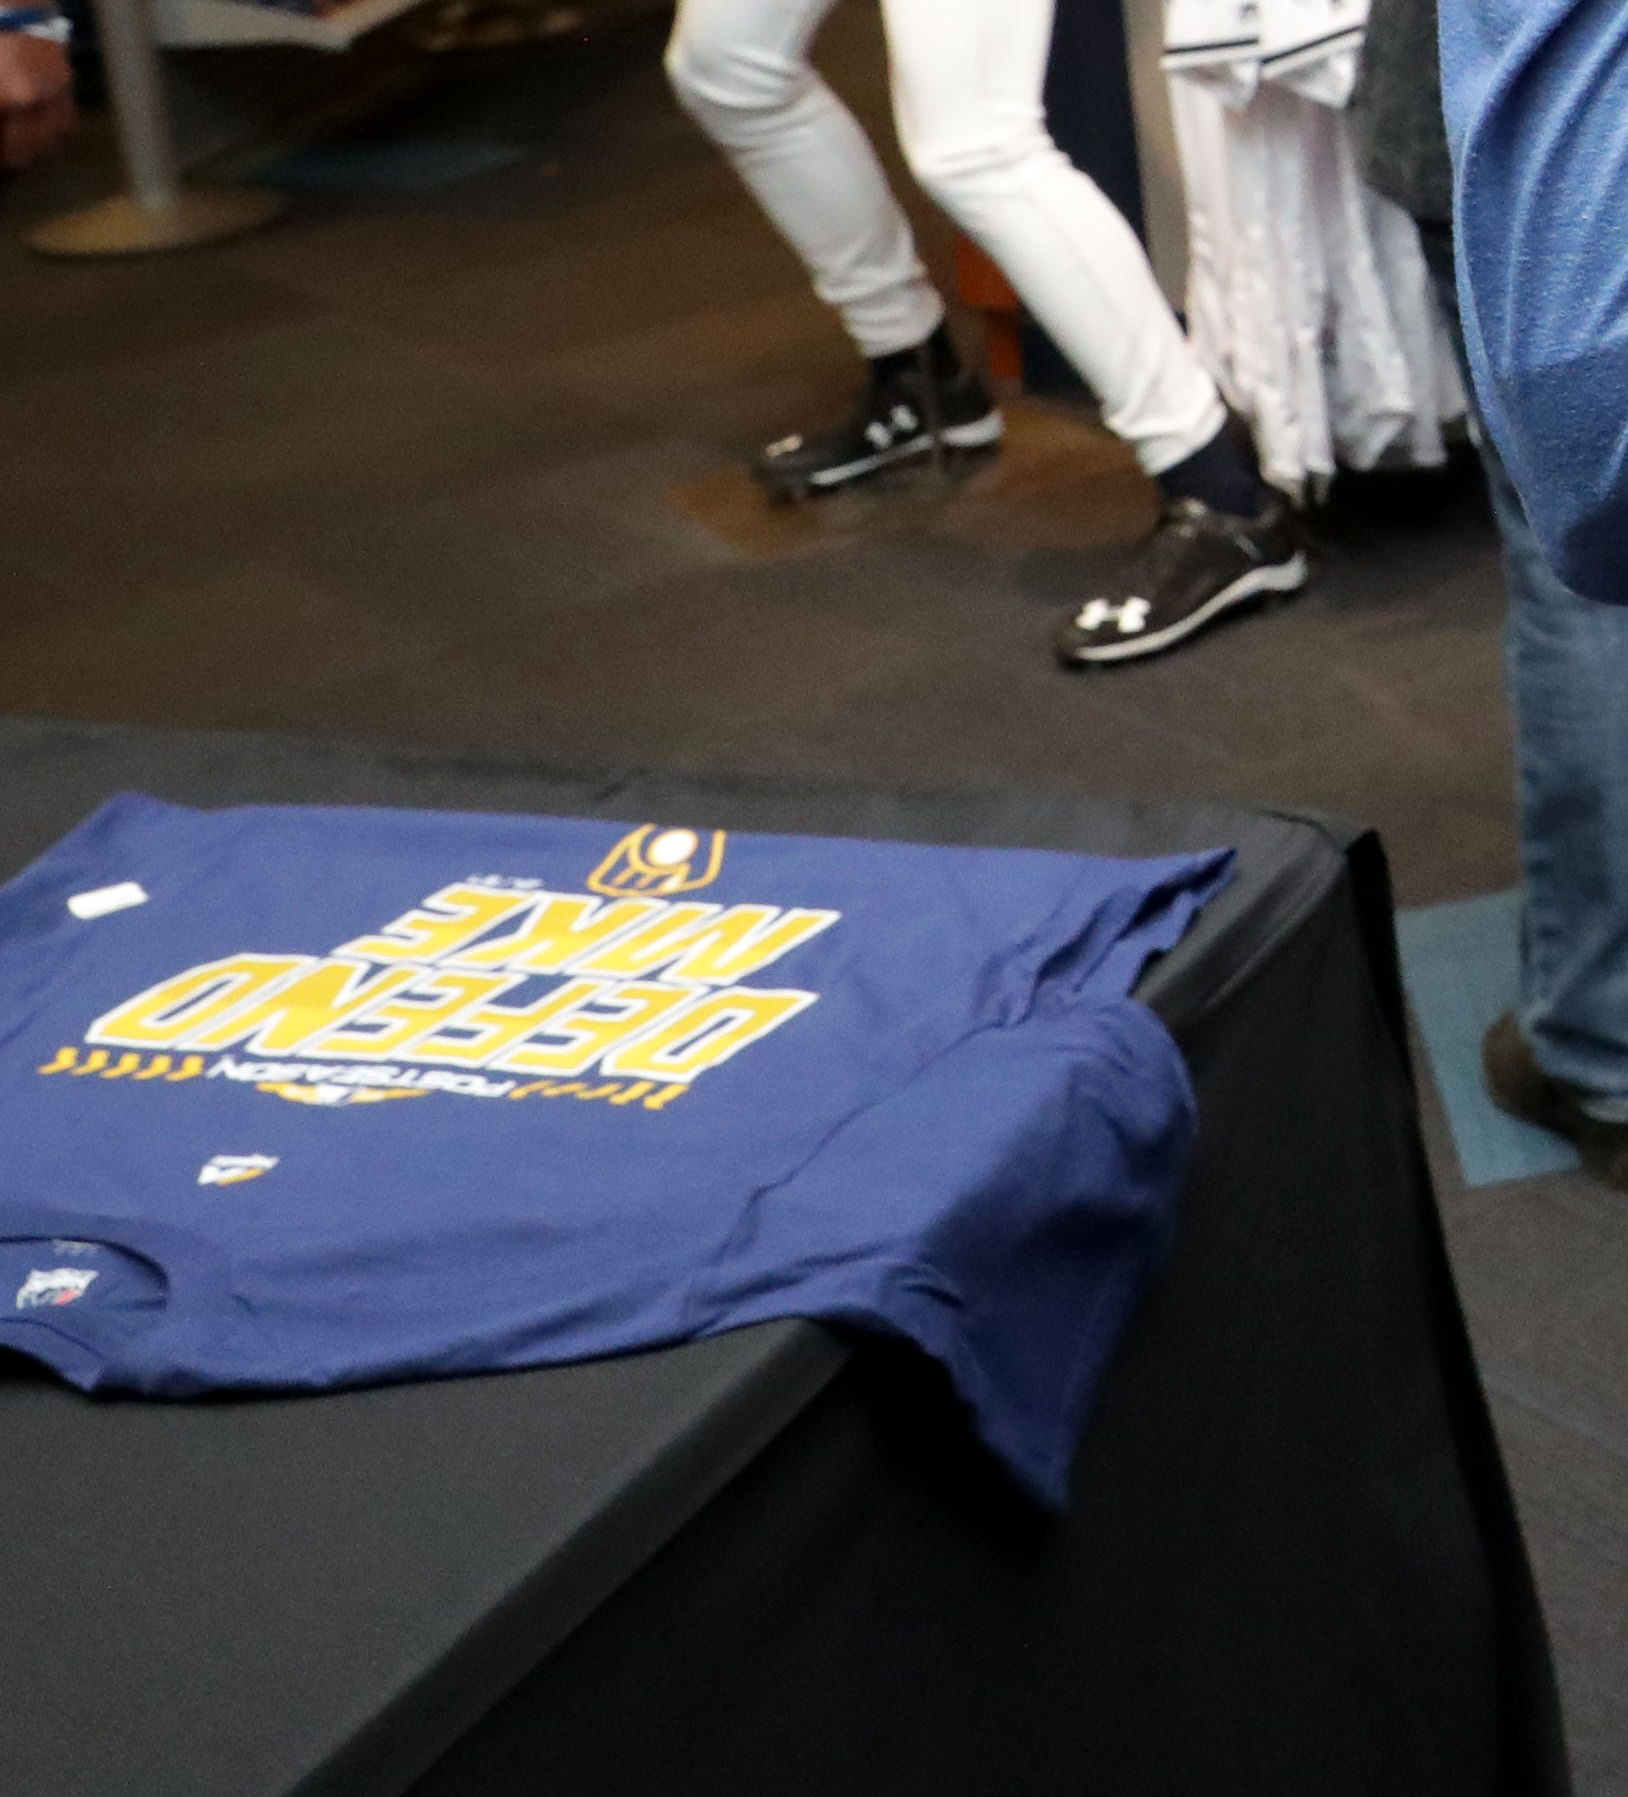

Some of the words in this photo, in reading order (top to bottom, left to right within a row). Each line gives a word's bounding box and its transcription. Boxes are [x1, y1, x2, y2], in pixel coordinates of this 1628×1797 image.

[330, 881, 841, 985] MKE
[84, 952, 821, 1083] DEFEND
[205, 1055, 518, 1098] POSTSEASON
